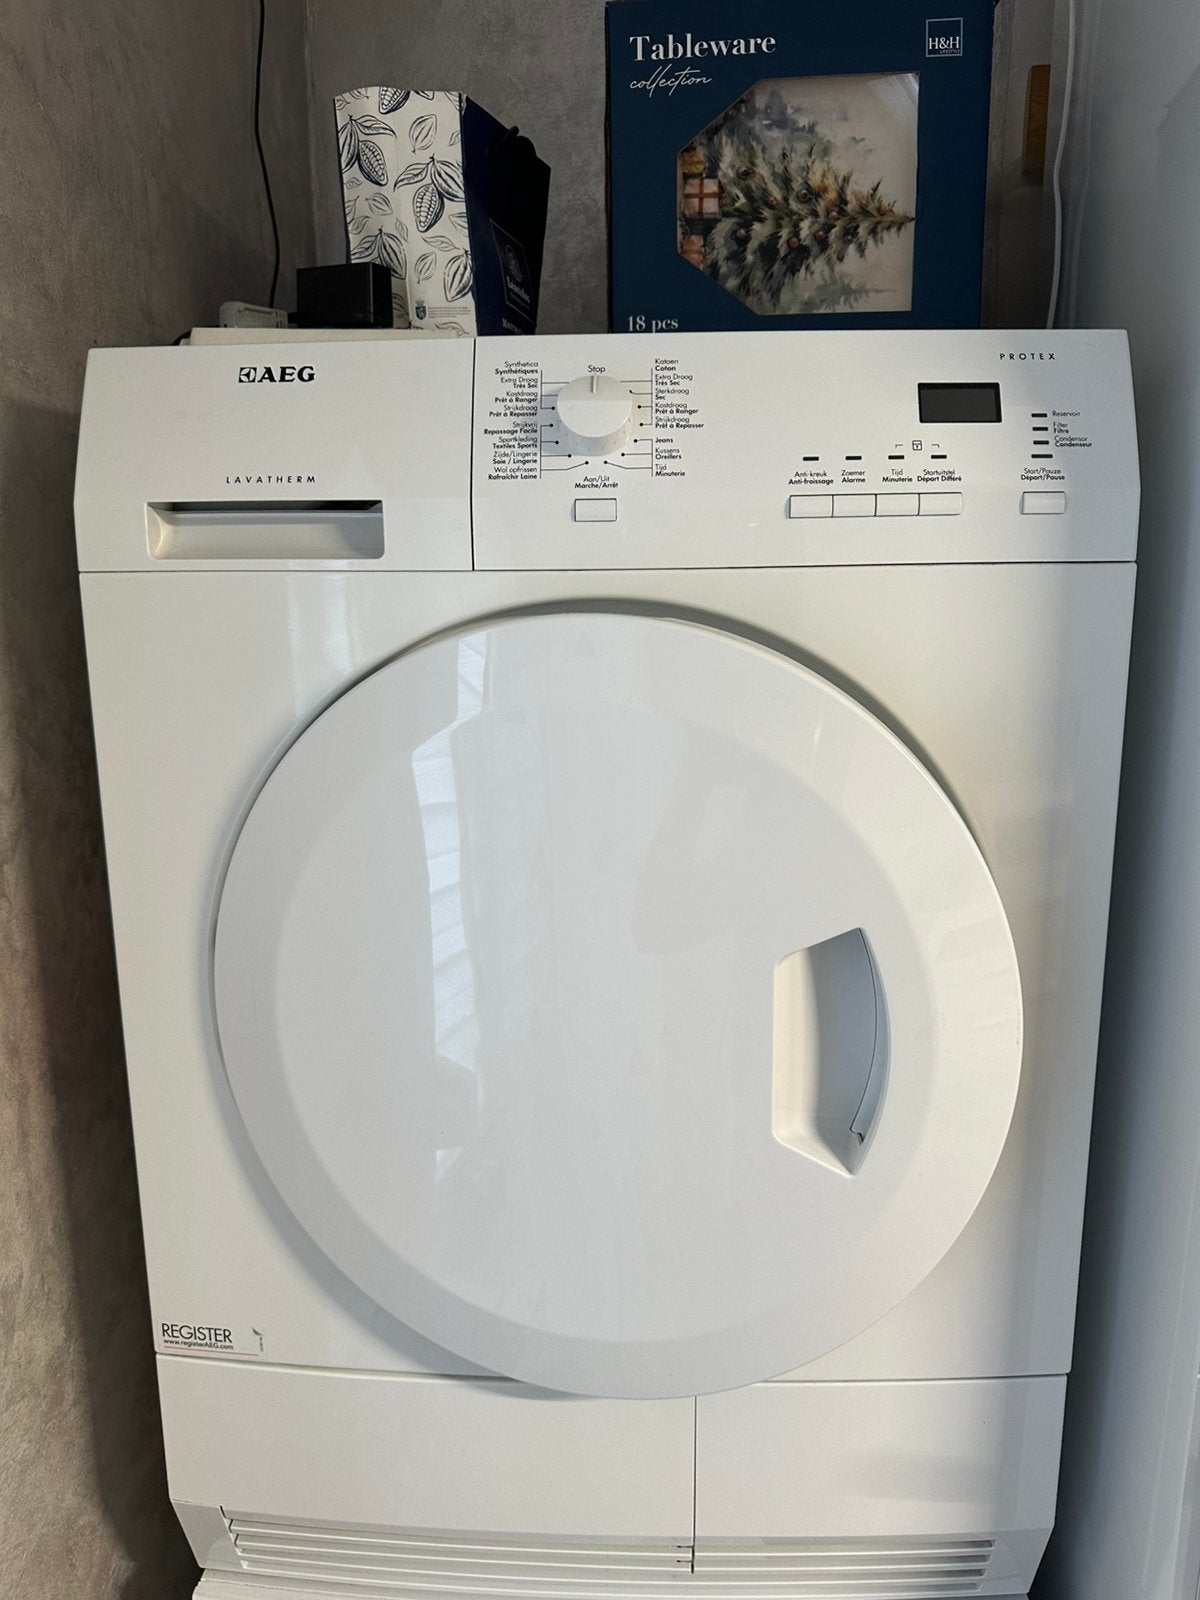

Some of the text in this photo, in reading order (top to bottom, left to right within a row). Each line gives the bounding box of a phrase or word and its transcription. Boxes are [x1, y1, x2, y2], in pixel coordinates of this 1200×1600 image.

[629, 33, 776, 62] Tableware
[928, 36, 960, 50] H&H
[629, 63, 712, 98] collection
[627, 316, 678, 332] 18 pcs
[1000, 352, 1056, 360] PROTEX
[257, 366, 316, 382] AEG
[588, 365, 606, 375] Stop
[891, 468, 903, 477] Tijd
[226, 476, 316, 484] LAVATHERM
[788, 477, 834, 485] Anti-froissage
[162, 1323, 233, 1343] REGISTER
[163, 1339, 234, 1350] www.registerAEG.com
